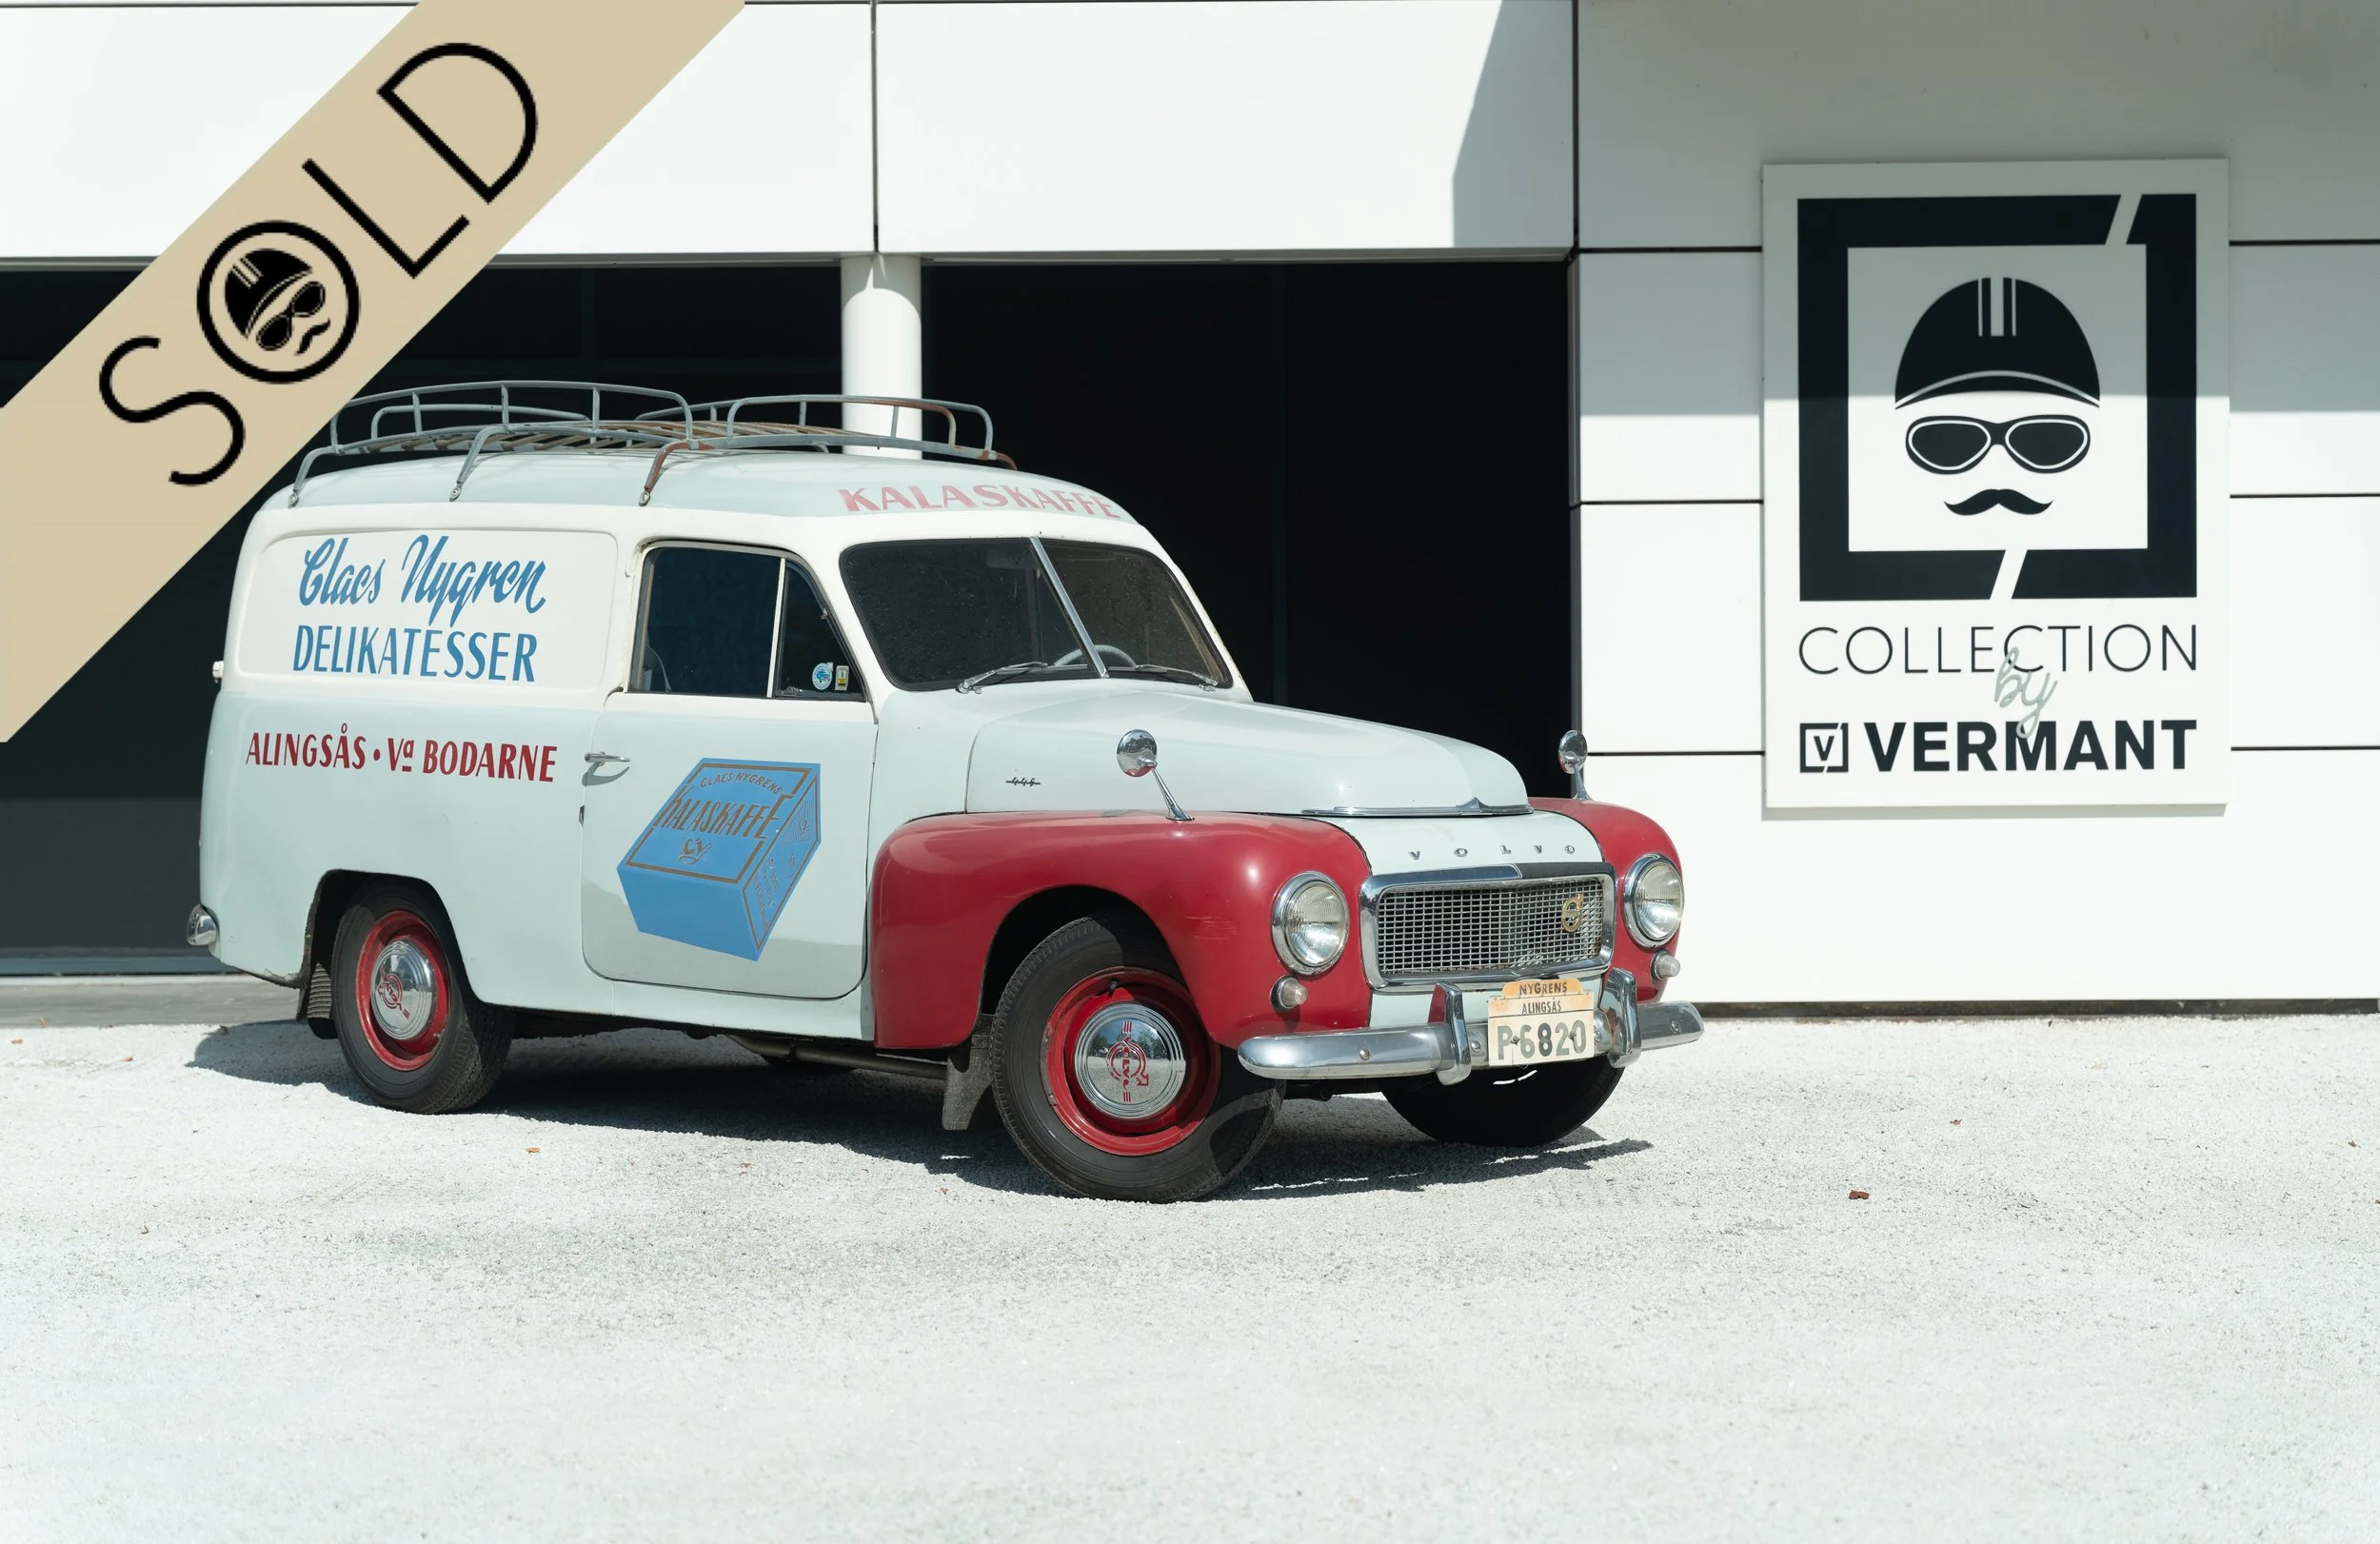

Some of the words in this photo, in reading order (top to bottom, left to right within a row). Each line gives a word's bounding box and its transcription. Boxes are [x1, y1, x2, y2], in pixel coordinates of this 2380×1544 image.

[838, 484, 1121, 519] KALASKAFFE
[299, 537, 386, 606] Claes
[401, 534, 546, 628] Nygren
[292, 624, 538, 683] DELIKATESSER
[1798, 624, 2197, 675] COLLECTION
[1993, 647, 2058, 739] by
[246, 723, 367, 770] ALINGSÅS
[423, 740, 558, 782] BODARNE
[1863, 720, 2197, 773] VERMANT
[700, 772, 734, 788] CLAES
[735, 772, 783, 796] NYGRENS
[1407, 844, 1576, 861] VOLVO
[1519, 982, 1568, 996] NYGRENS
[1497, 1019, 1587, 1060] P6820
